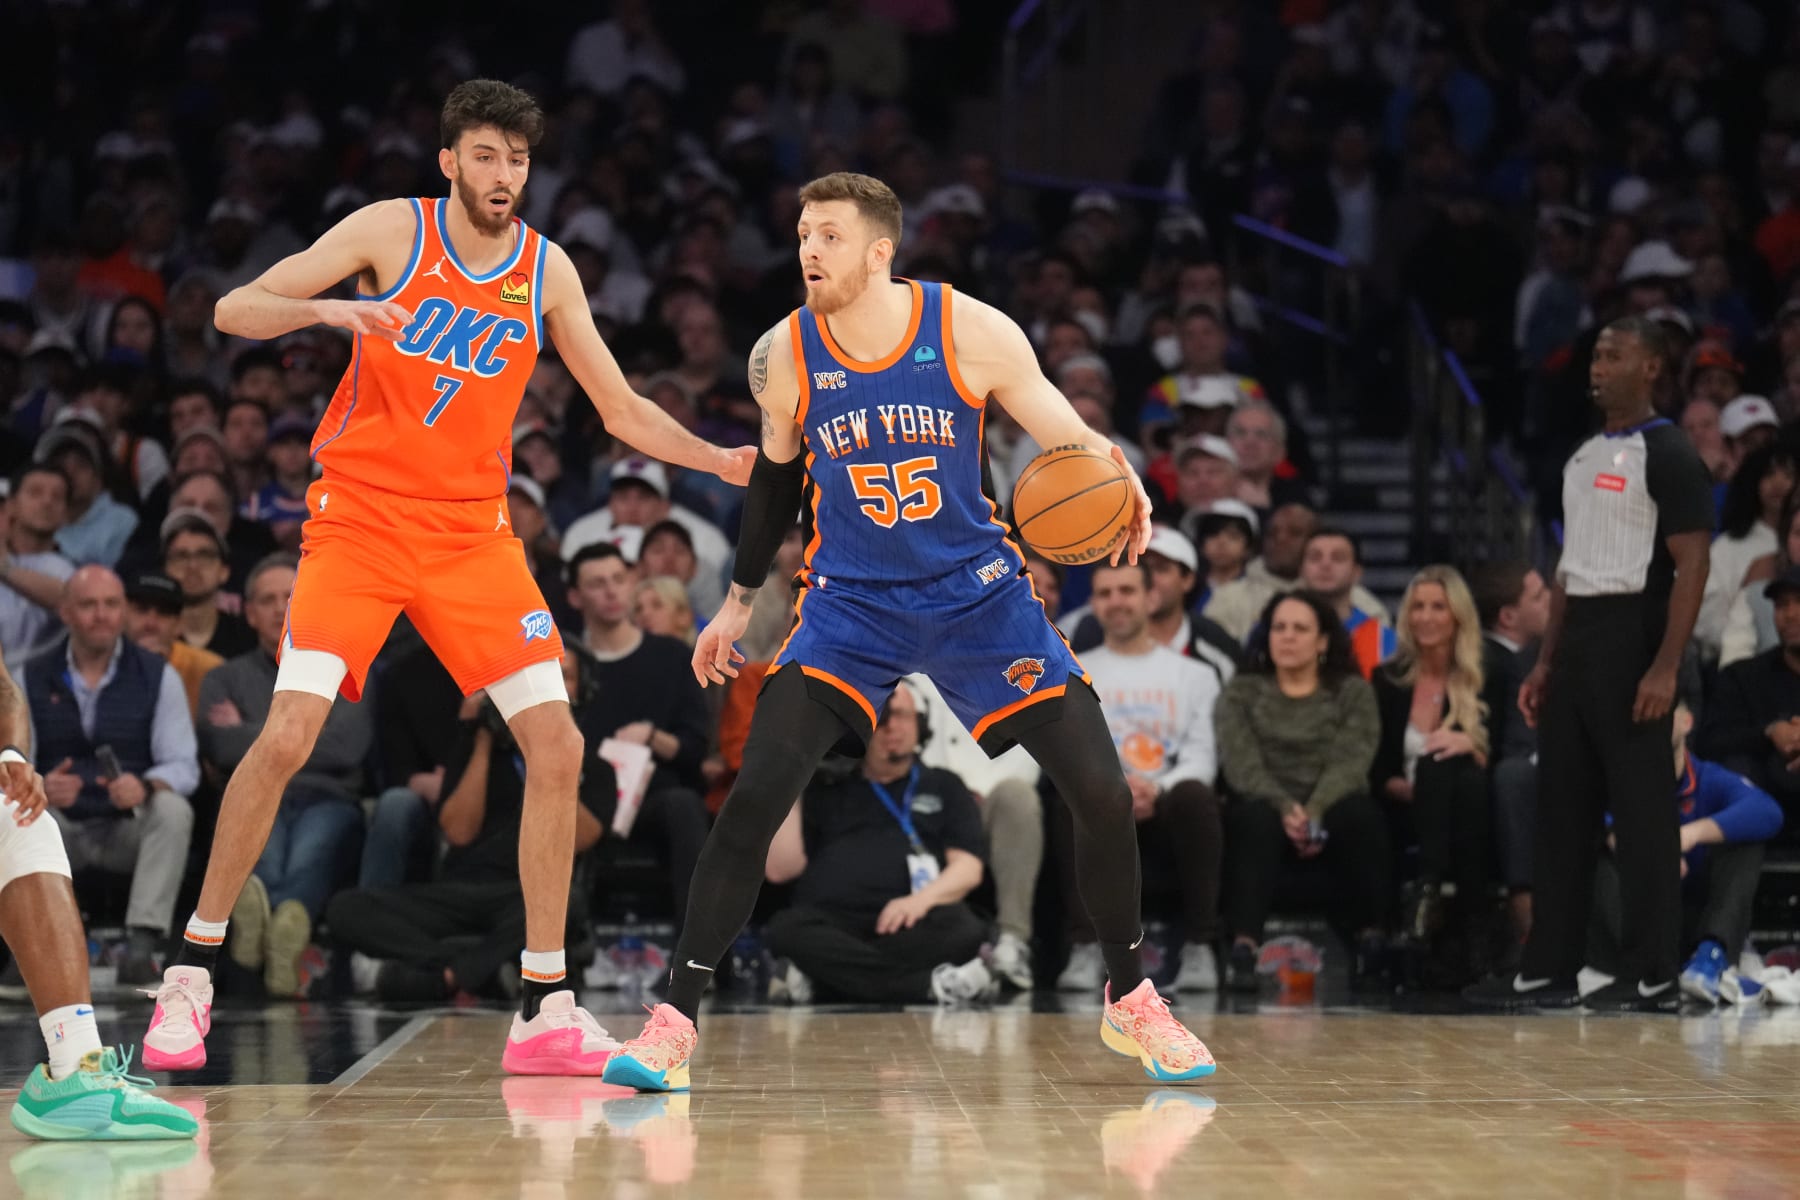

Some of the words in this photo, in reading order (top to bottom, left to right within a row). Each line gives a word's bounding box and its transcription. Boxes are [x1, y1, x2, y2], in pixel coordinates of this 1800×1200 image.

[393, 297, 528, 378] OKC
[814, 371, 847, 389] NYC
[912, 362, 941, 373] sphere
[423, 374, 464, 428] 7
[817, 408, 869, 459] NEW
[877, 404, 956, 447] YORK
[846, 456, 942, 529] 55
[976, 558, 1010, 585] NYC
[525, 613, 548, 640] OKC
[1009, 659, 1044, 684] KNICKS
